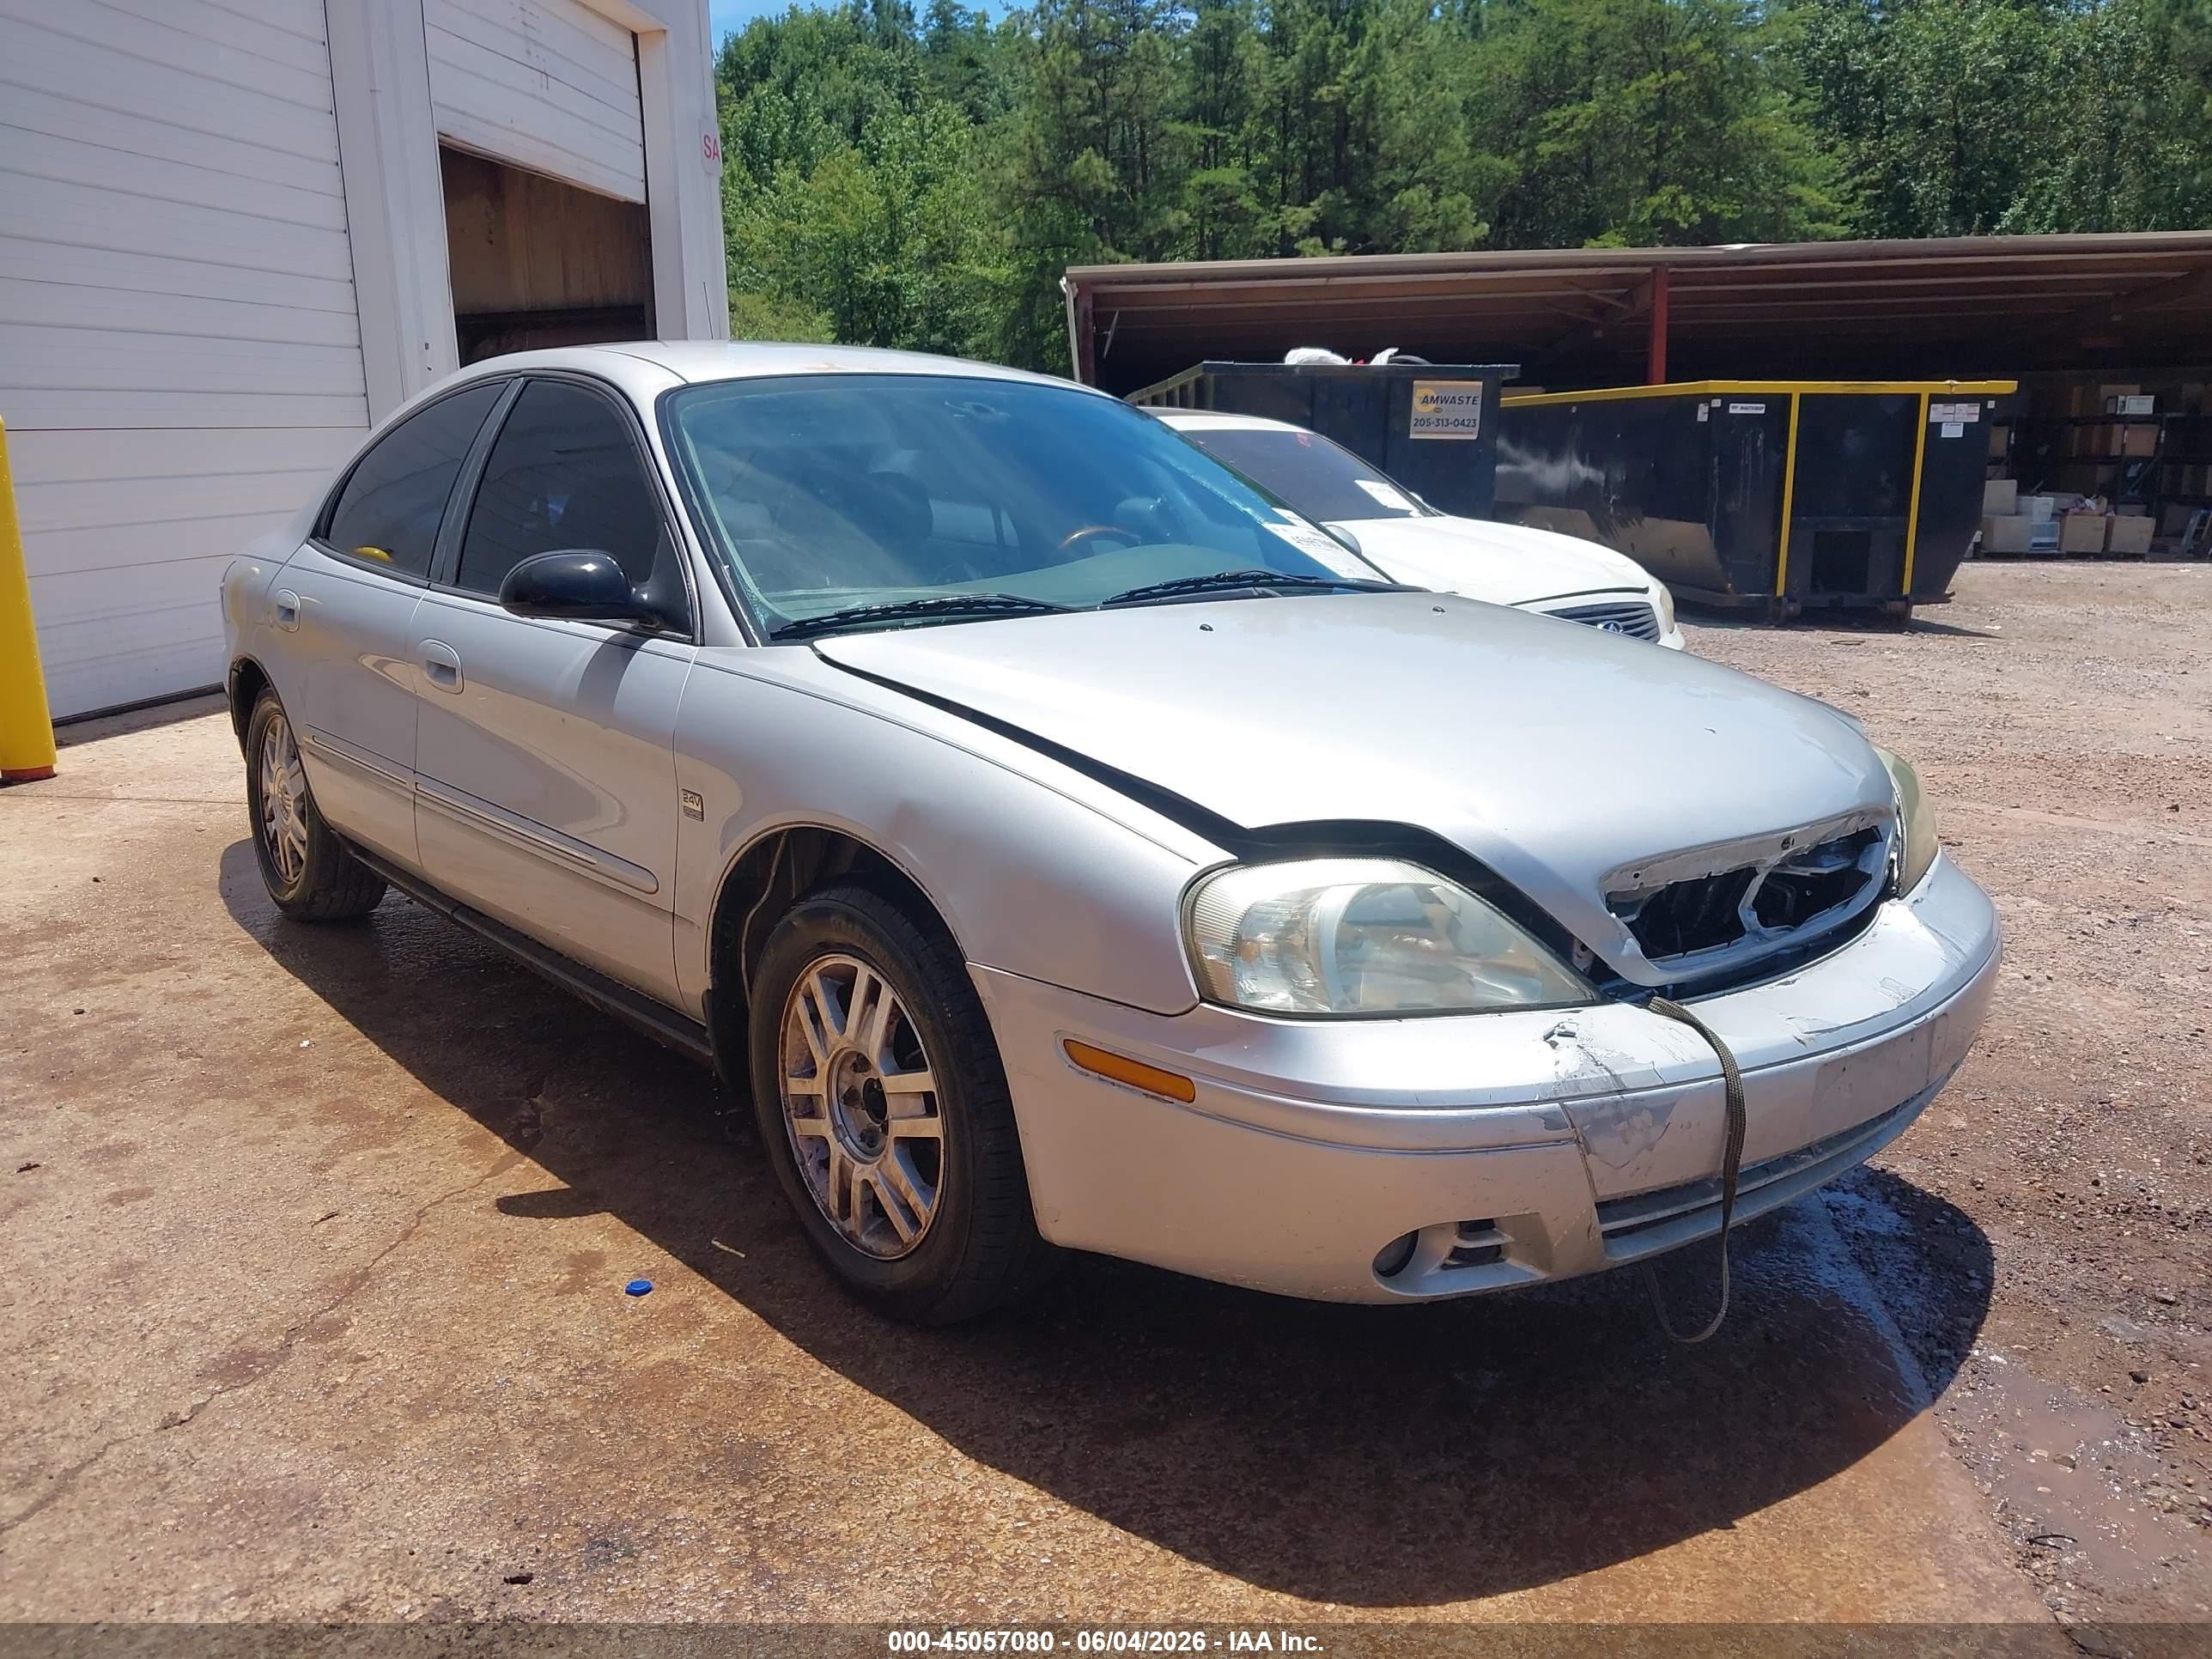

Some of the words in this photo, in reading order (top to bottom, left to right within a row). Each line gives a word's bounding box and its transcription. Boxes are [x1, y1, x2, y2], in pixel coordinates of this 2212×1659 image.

[1420, 395, 1480, 405] AMWASTE
[1413, 417, 1477, 428] 205-313-0423
[683, 793, 701, 807] 24V
